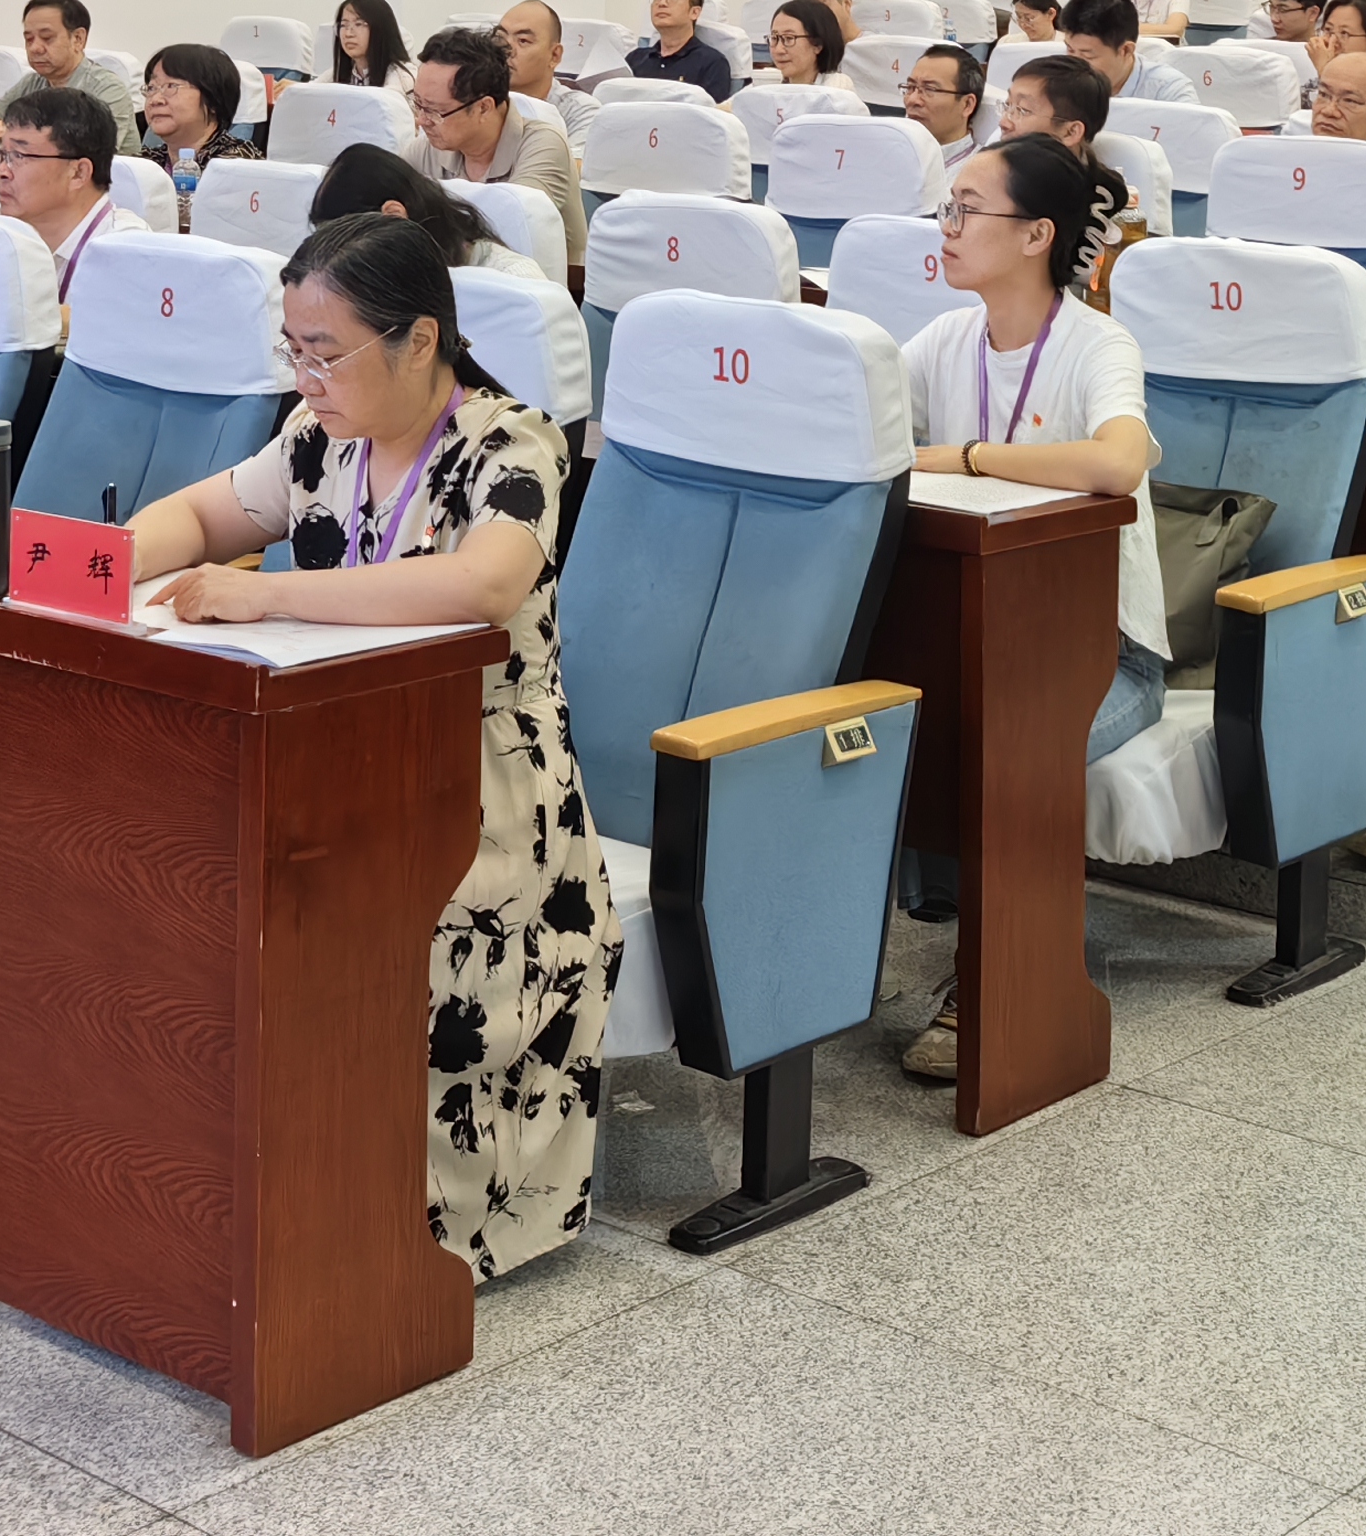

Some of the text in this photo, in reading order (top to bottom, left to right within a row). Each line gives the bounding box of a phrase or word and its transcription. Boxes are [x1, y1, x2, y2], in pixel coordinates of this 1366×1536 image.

[252, 24, 260, 38] 1
[577, 33, 585, 48] 2
[891, 58, 901, 75] 4
[1202, 70, 1213, 87] 6
[326, 109, 337, 127] 4
[776, 107, 784, 124] 5
[648, 128, 659, 149] 6
[1150, 126, 1161, 141] 7
[834, 149, 846, 170] 7
[1292, 167, 1307, 192] 9
[249, 191, 260, 214] 6
[667, 236, 680, 263] 8
[924, 254, 938, 283] 9
[161, 287, 174, 318] 8
[1209, 281, 1244, 313] 10
[713, 347, 750, 385] 10
